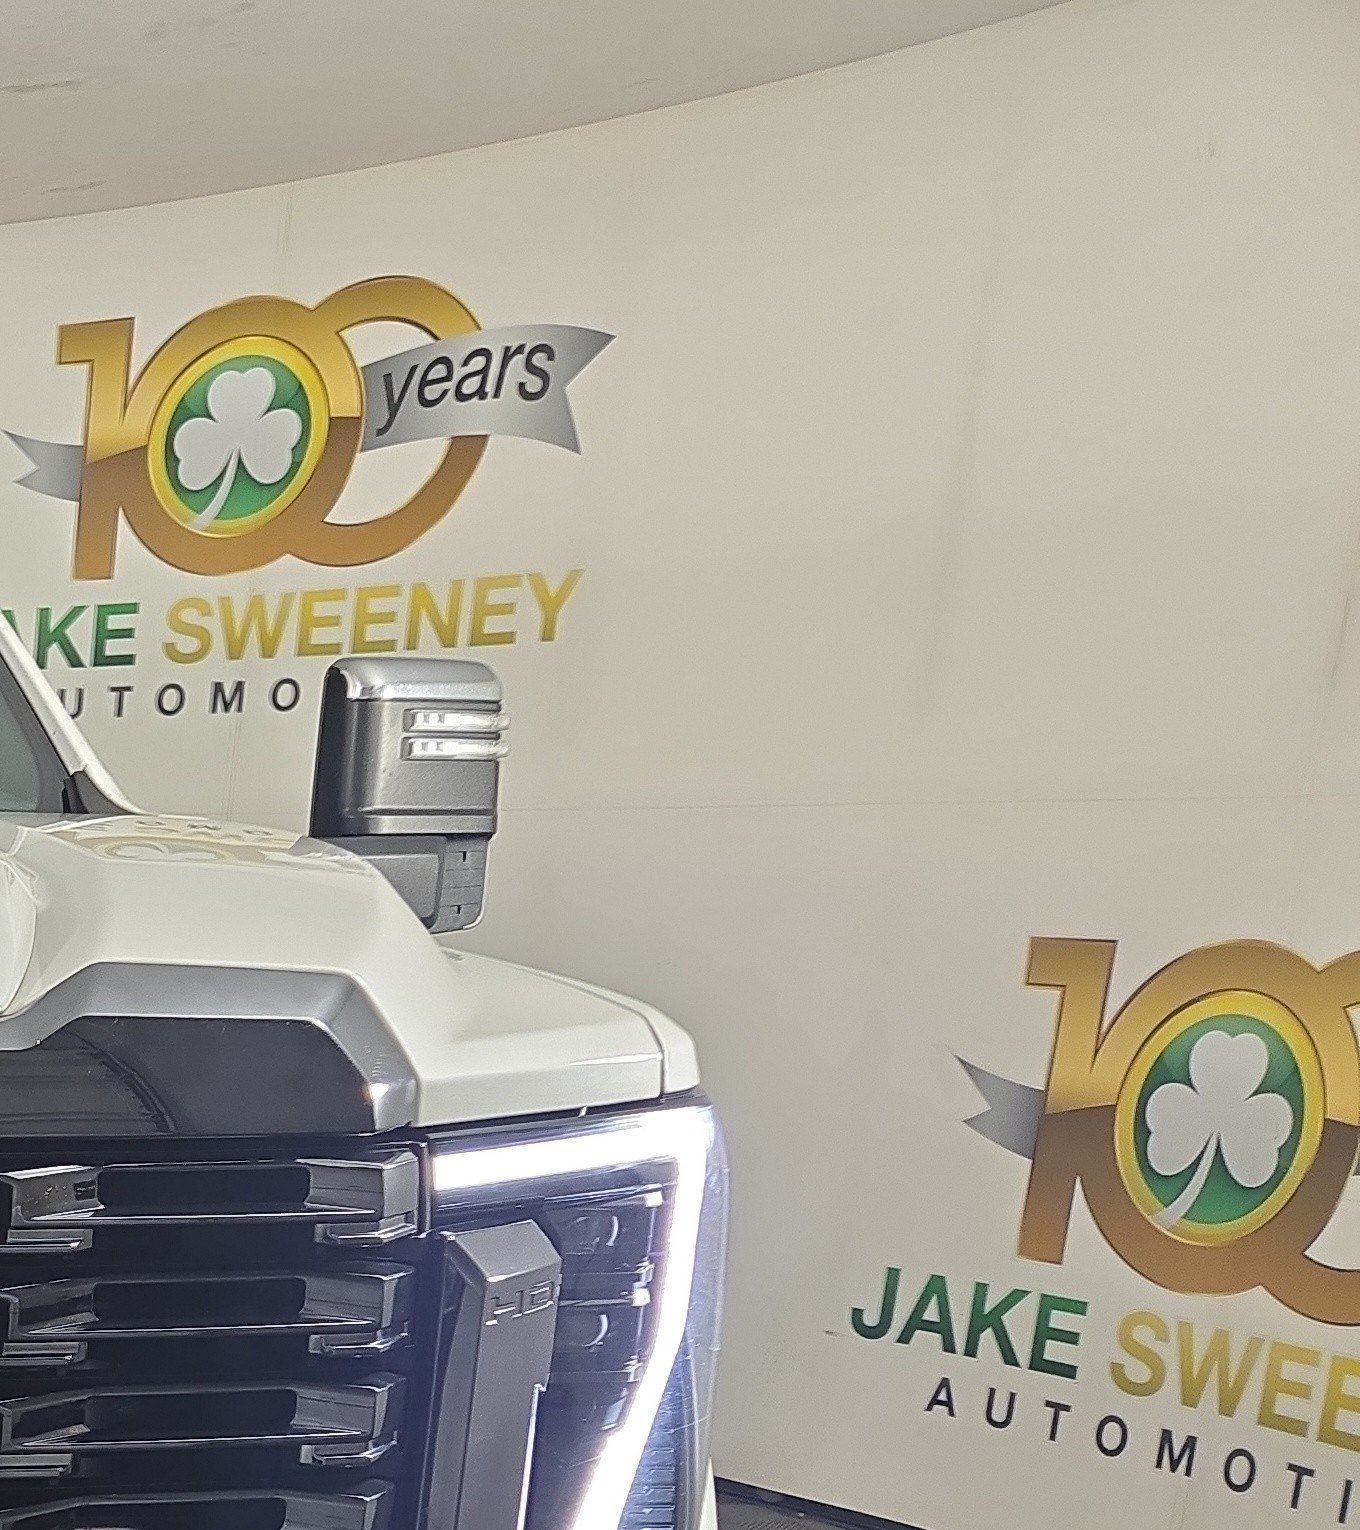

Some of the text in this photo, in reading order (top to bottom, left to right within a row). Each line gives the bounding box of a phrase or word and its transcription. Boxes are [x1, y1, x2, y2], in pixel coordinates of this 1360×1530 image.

[374, 340, 556, 437] years
[1, 570, 584, 670] KE SWEENEY
[55, 678, 302, 720] UTOMO
[850, 1266, 1360, 1453] JAKE SWEE
[924, 1377, 1353, 1524] AUTOMOTI
